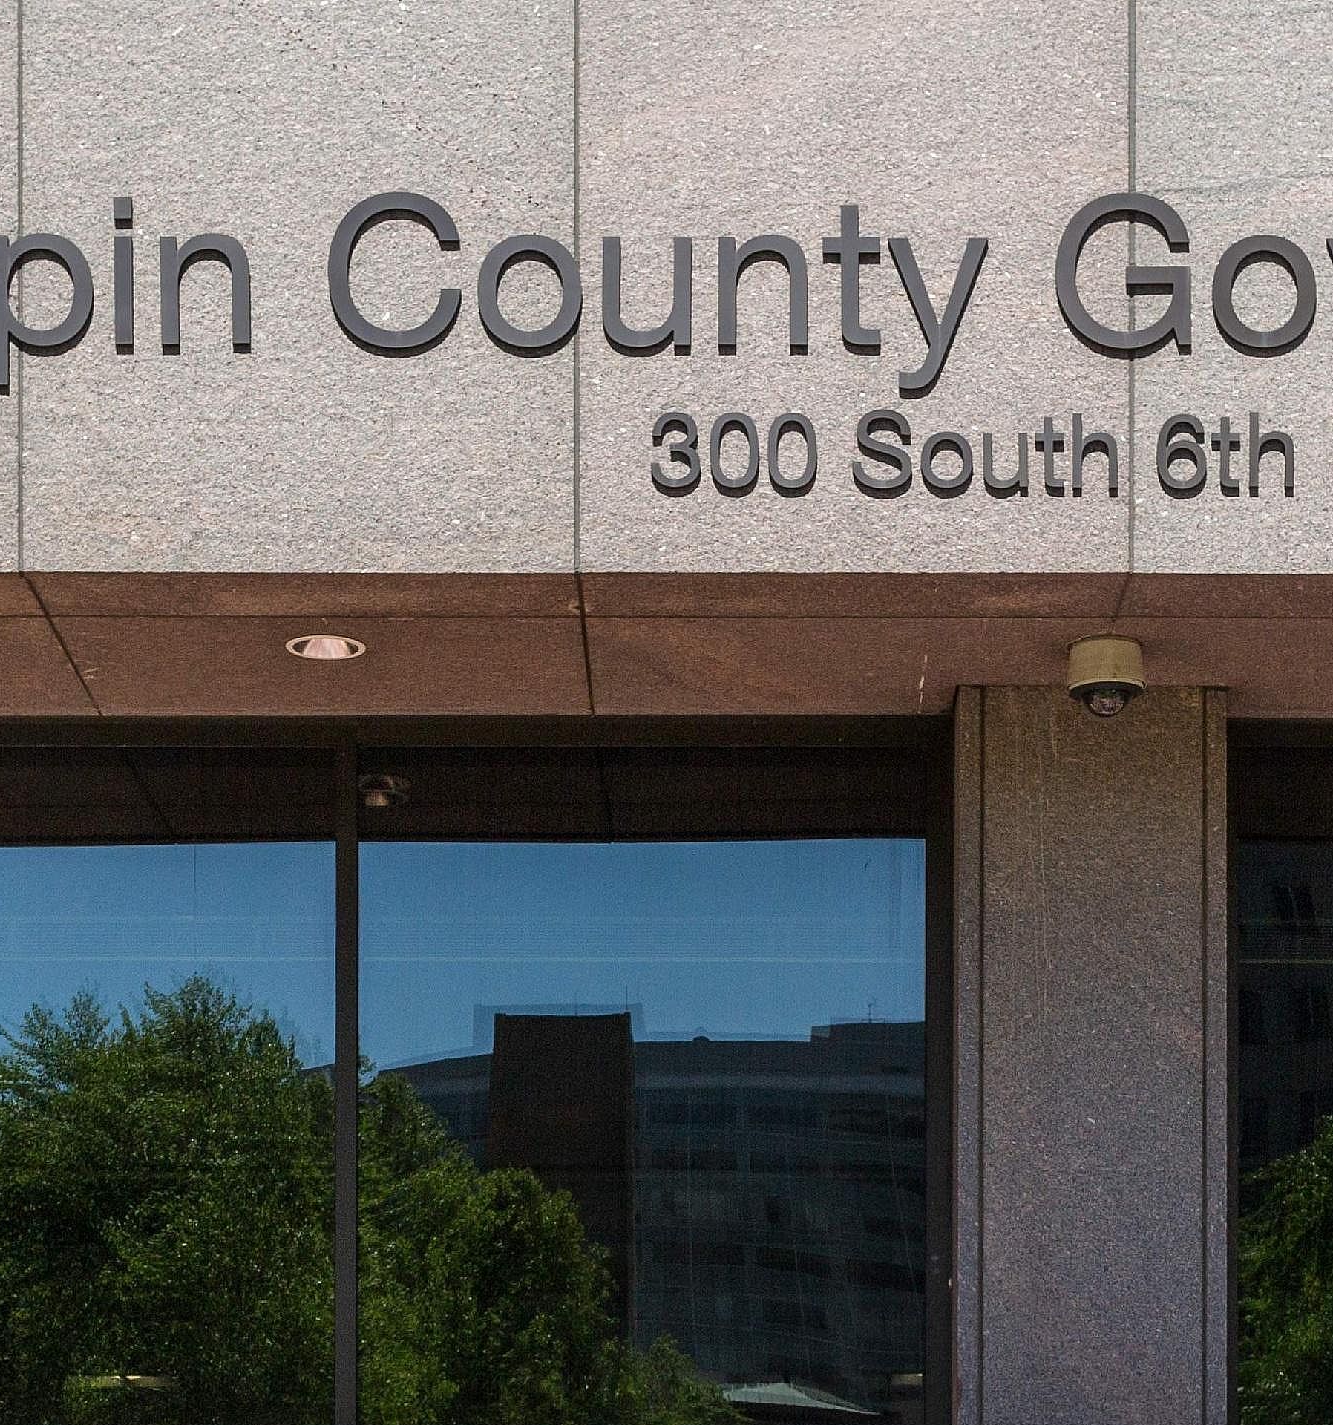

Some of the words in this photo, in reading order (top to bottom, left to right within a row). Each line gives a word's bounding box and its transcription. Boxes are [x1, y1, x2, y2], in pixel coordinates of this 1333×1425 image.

[327, 190, 990, 396] County
[652, 412, 818, 499] 300
[852, 409, 1119, 500] South
[1156, 414, 1295, 500] 6th
